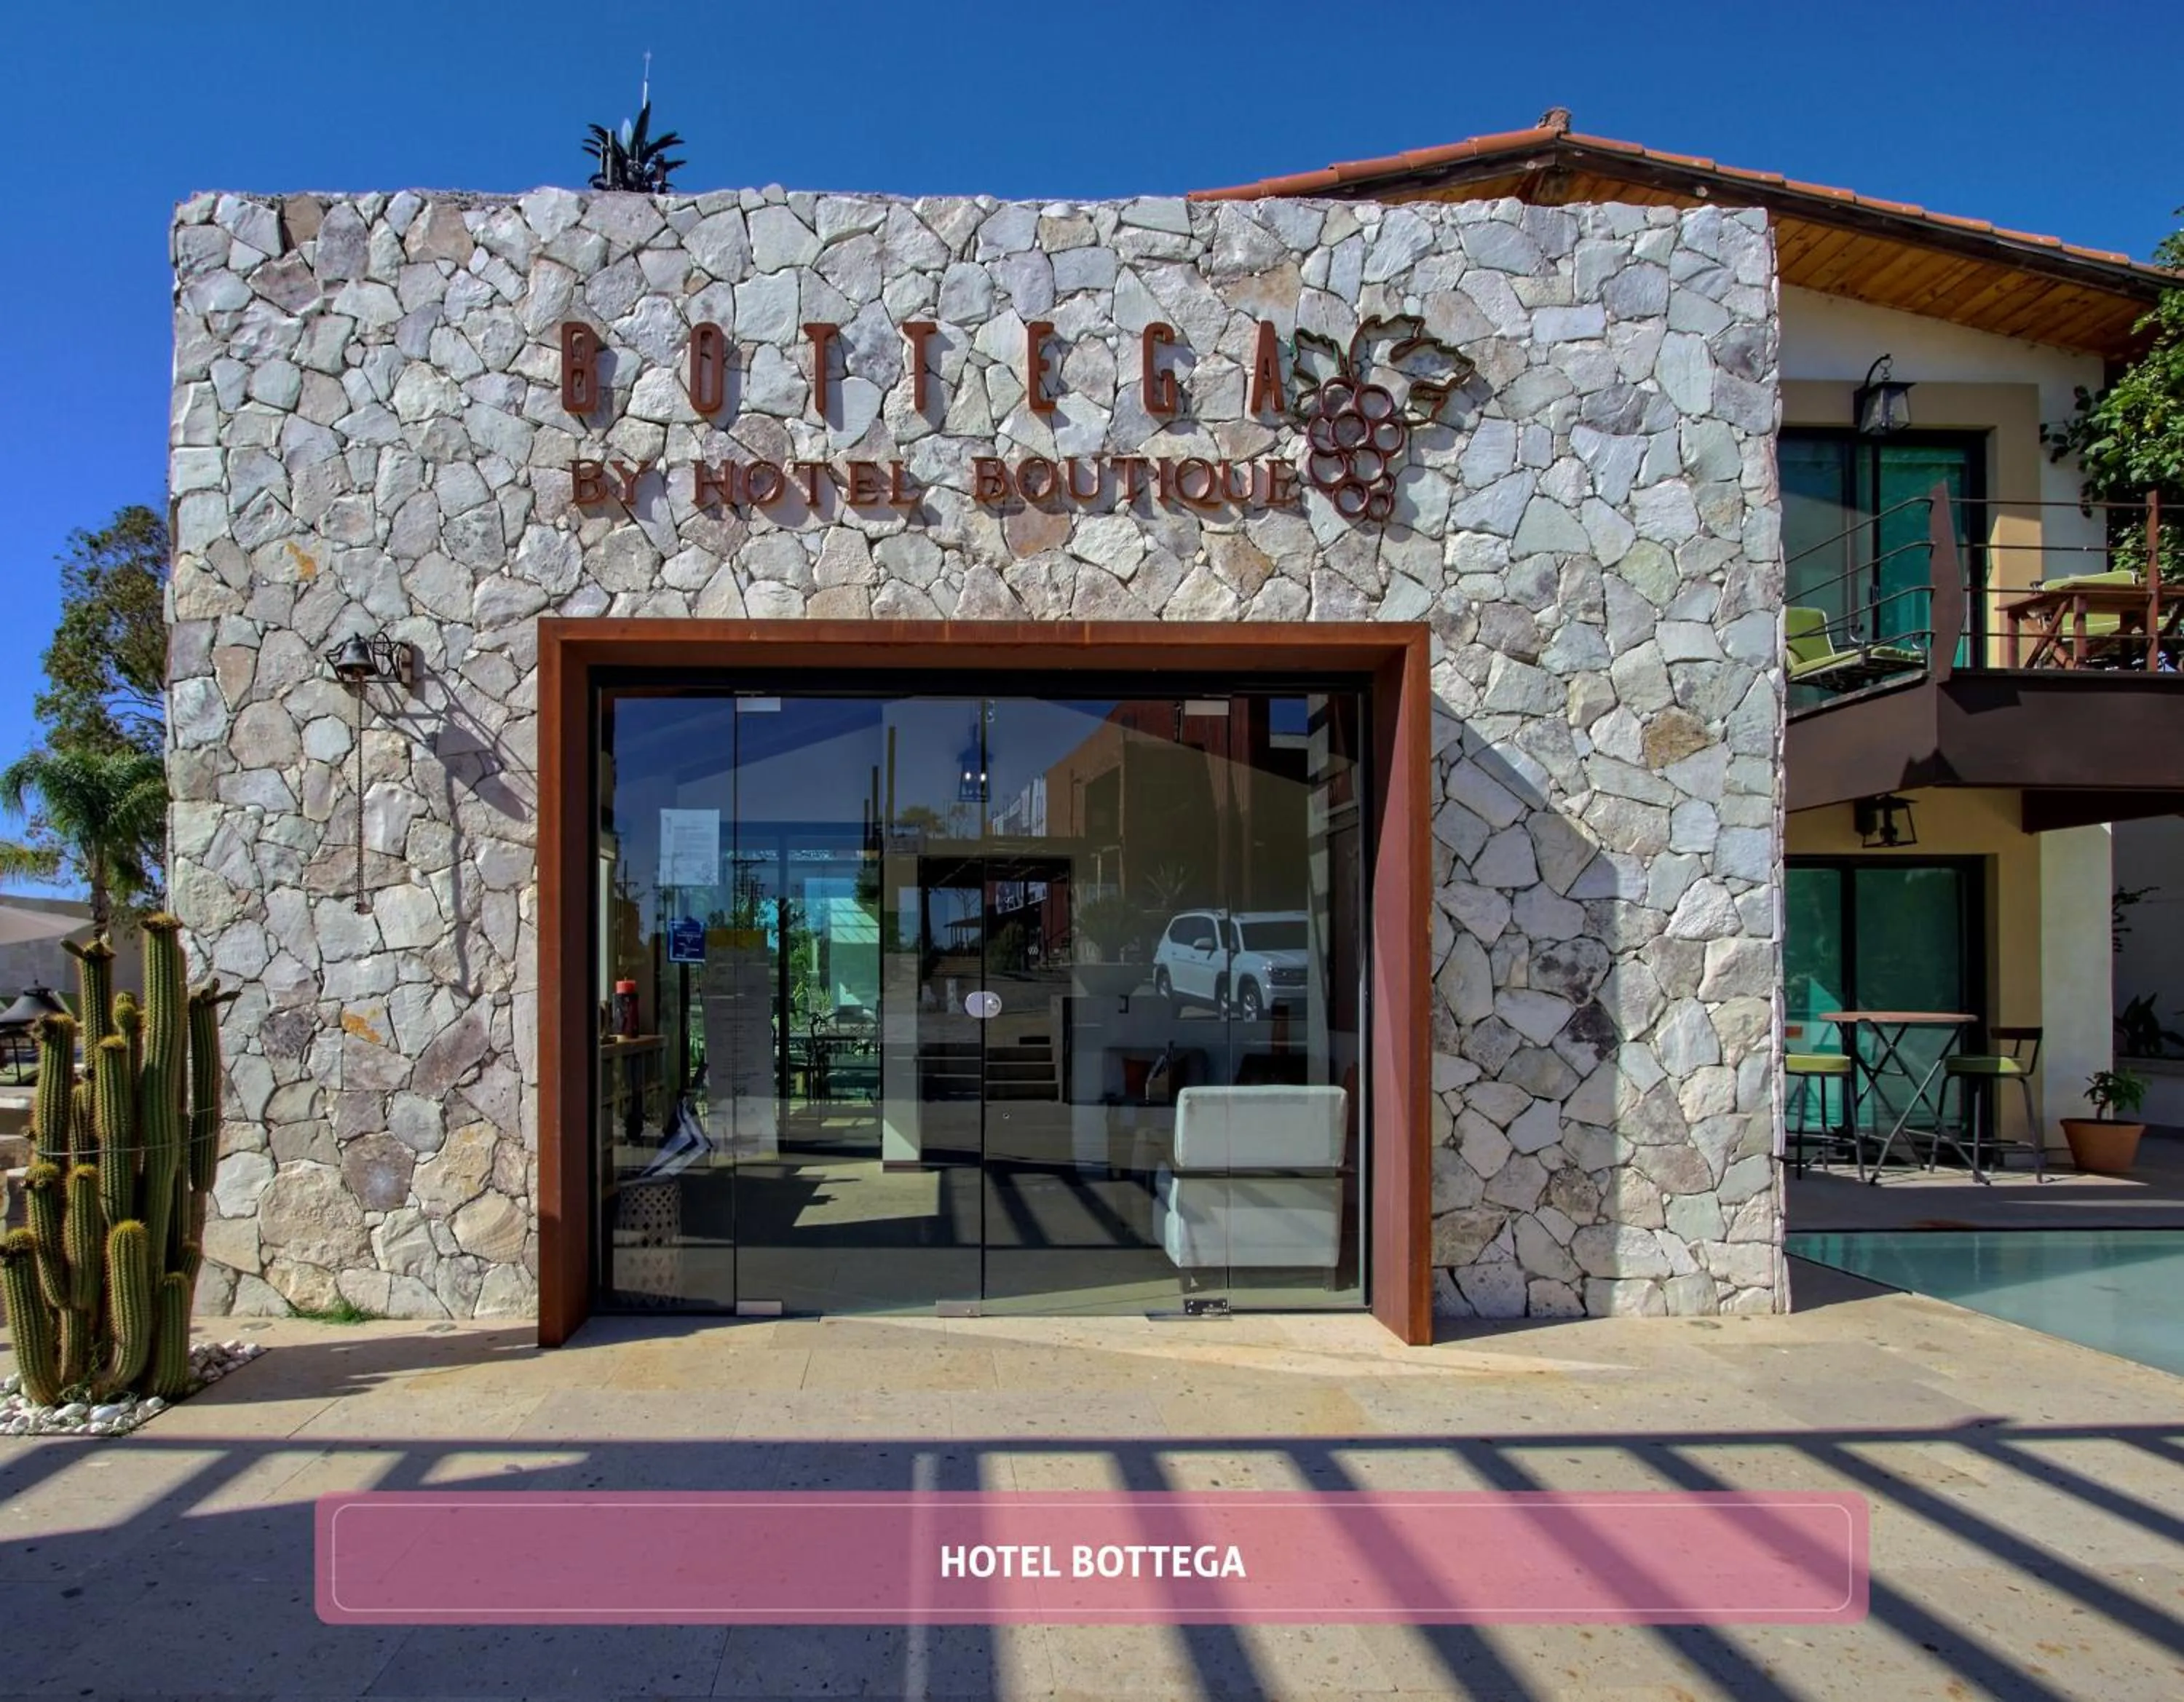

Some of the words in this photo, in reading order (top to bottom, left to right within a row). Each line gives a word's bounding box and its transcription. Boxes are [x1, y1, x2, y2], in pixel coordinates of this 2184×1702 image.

[561, 320, 1285, 413] BOTTEGA
[569, 459, 652, 506] BY
[691, 459, 919, 507] HOTEL
[971, 456, 1299, 507] BOUTIQUE
